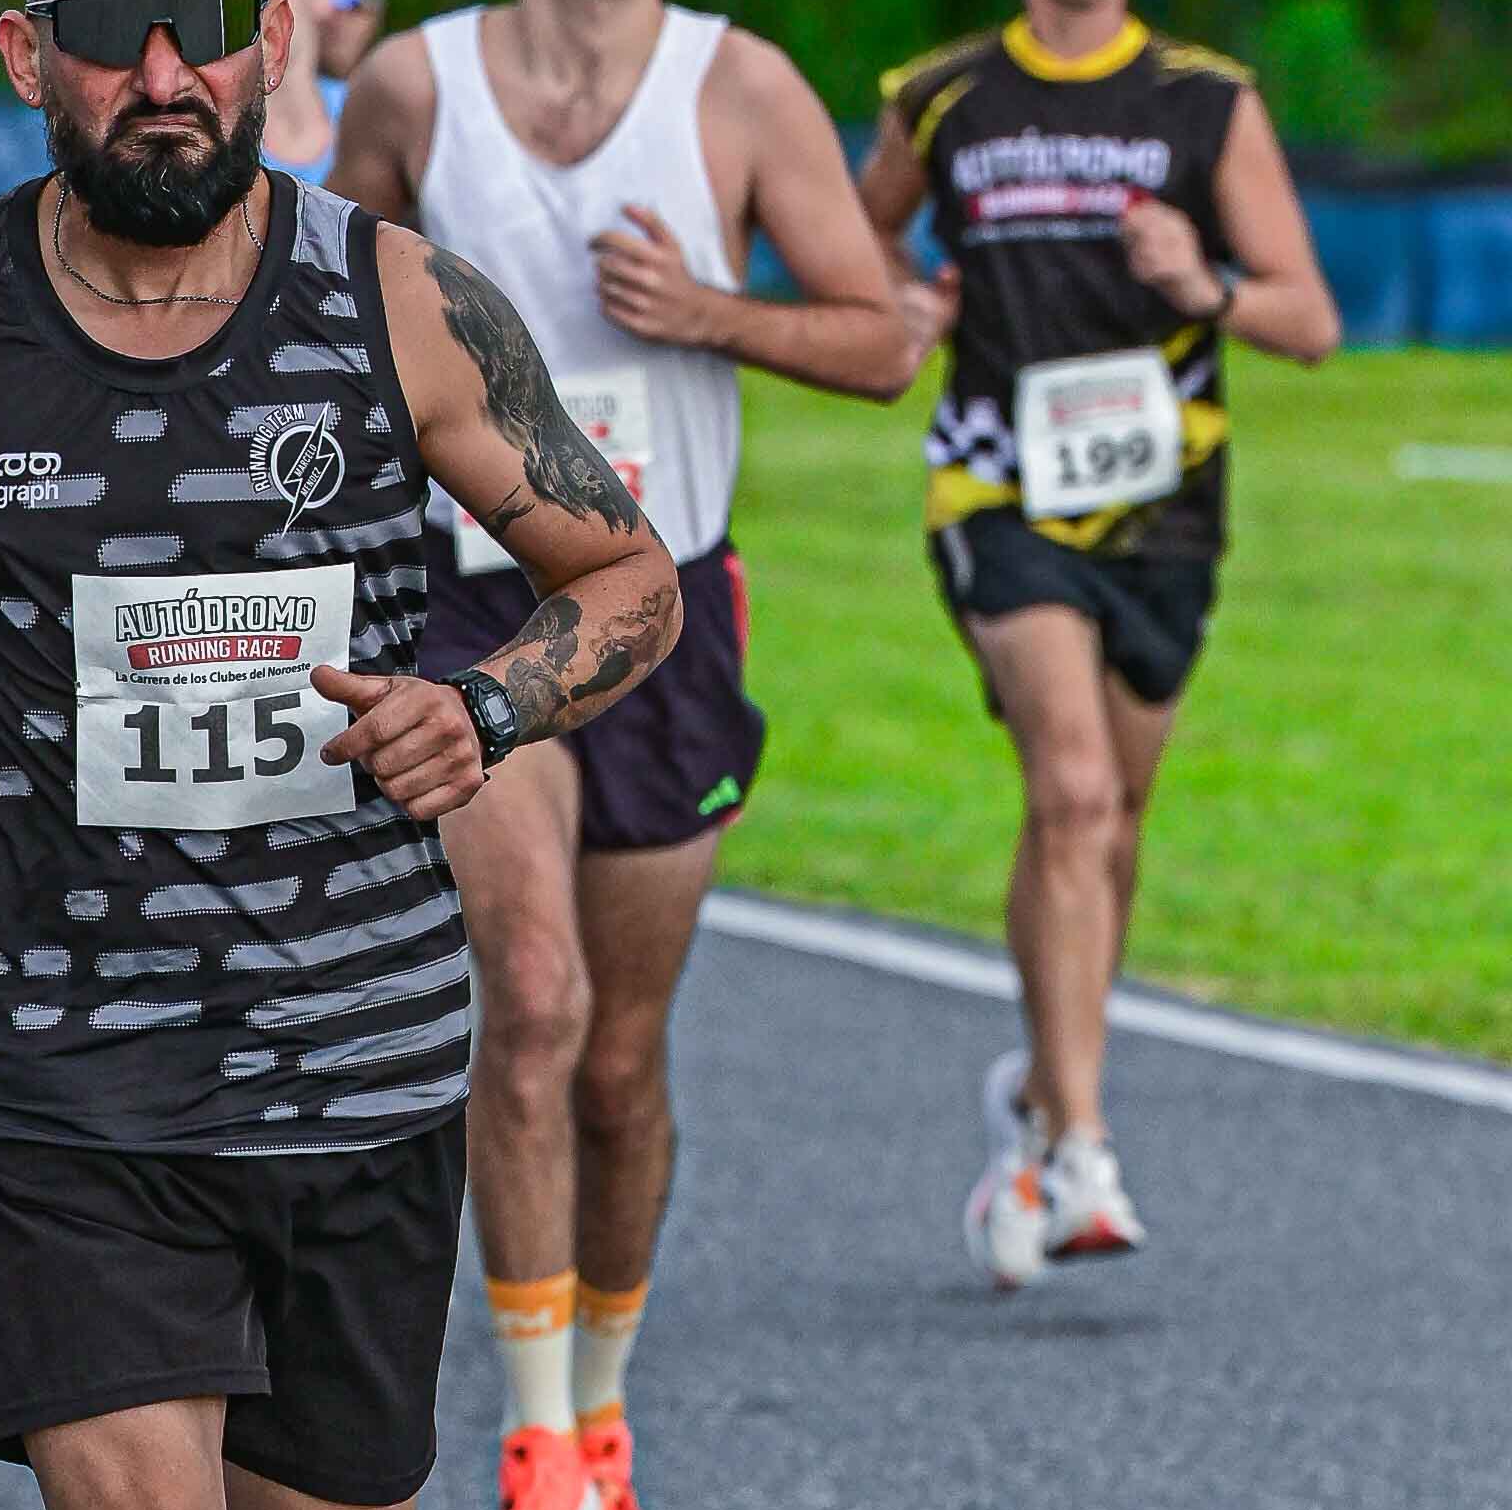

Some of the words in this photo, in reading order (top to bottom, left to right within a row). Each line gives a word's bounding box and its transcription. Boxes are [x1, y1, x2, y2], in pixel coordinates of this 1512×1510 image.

[248, 424, 275, 493] RUNNING
[265, 403, 306, 431] TEAM
[293, 442, 318, 478] MARCELO
[1055, 429, 1155, 488] 199
[300, 466, 322, 498] MENDEZ
[115, 587, 317, 642] AUTÓDROMO
[115, 671, 128, 682] La
[130, 673, 171, 685] Carrera
[173, 673, 188, 685] de
[190, 672, 207, 684] los
[209, 669, 248, 684] Clubes
[250, 667, 266, 680] del
[268, 662, 311, 677] Noroeste
[147, 639, 231, 666] RUNNING
[237, 638, 284, 659] RACE
[123, 691, 306, 784] 115
